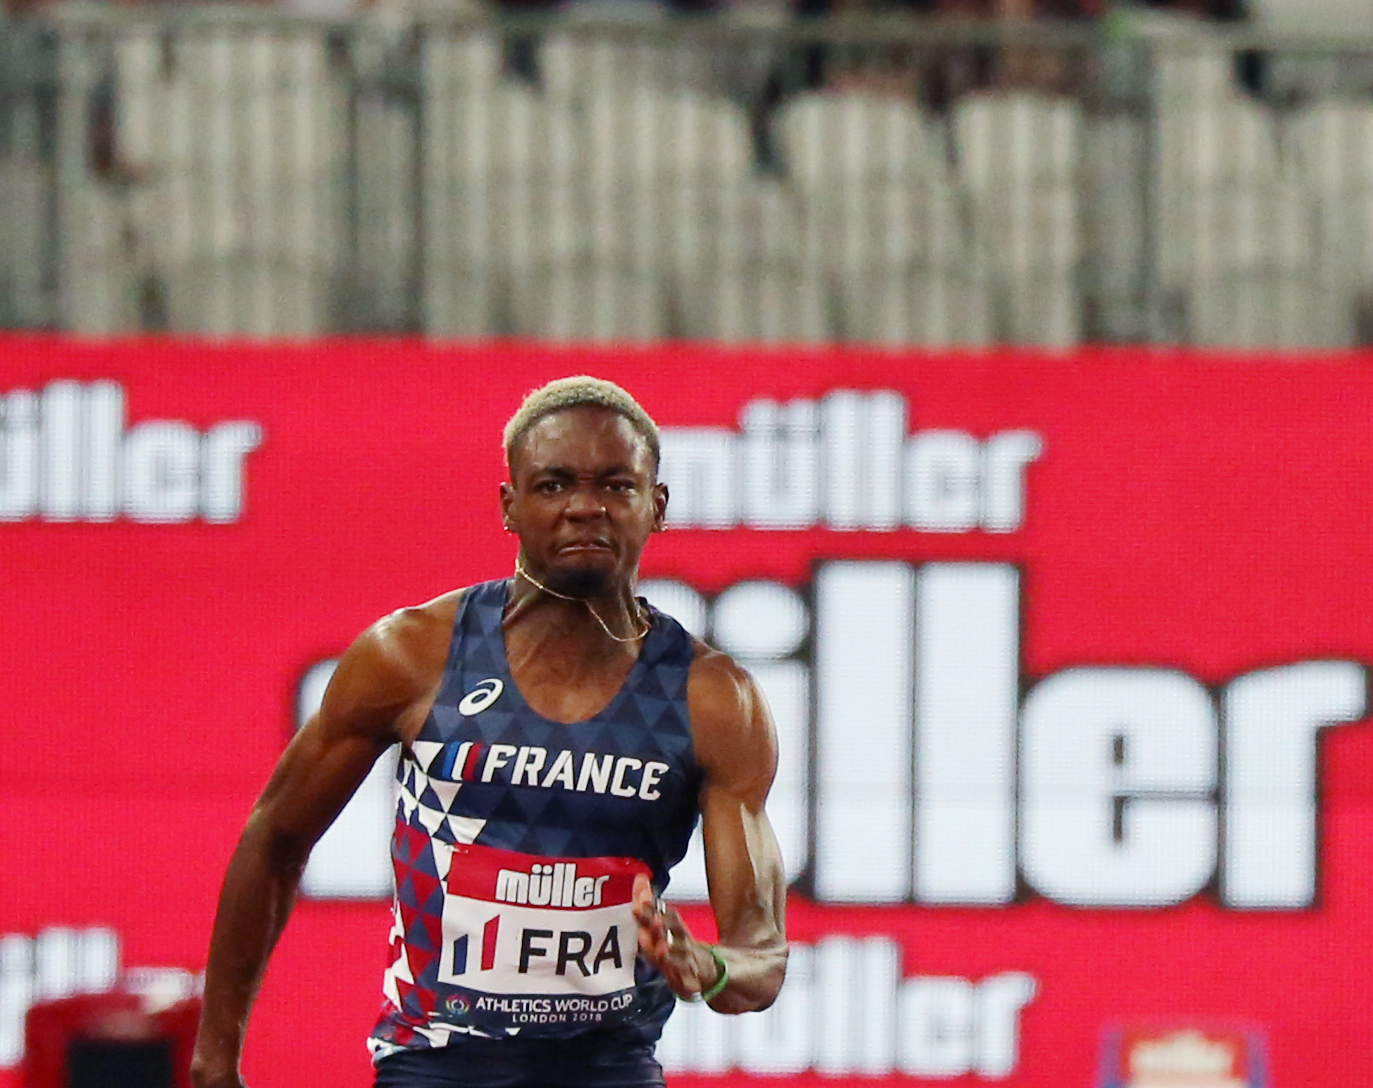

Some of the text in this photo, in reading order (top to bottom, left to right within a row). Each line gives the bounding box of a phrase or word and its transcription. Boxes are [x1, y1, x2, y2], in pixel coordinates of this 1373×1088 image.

[481, 743, 670, 801] FRANCE
[495, 862, 611, 908] müller
[517, 925, 624, 978] FRA
[475, 993, 634, 1013] ATHLETICS WORLD CUP
[512, 1012, 603, 1024] LONDON 2018
